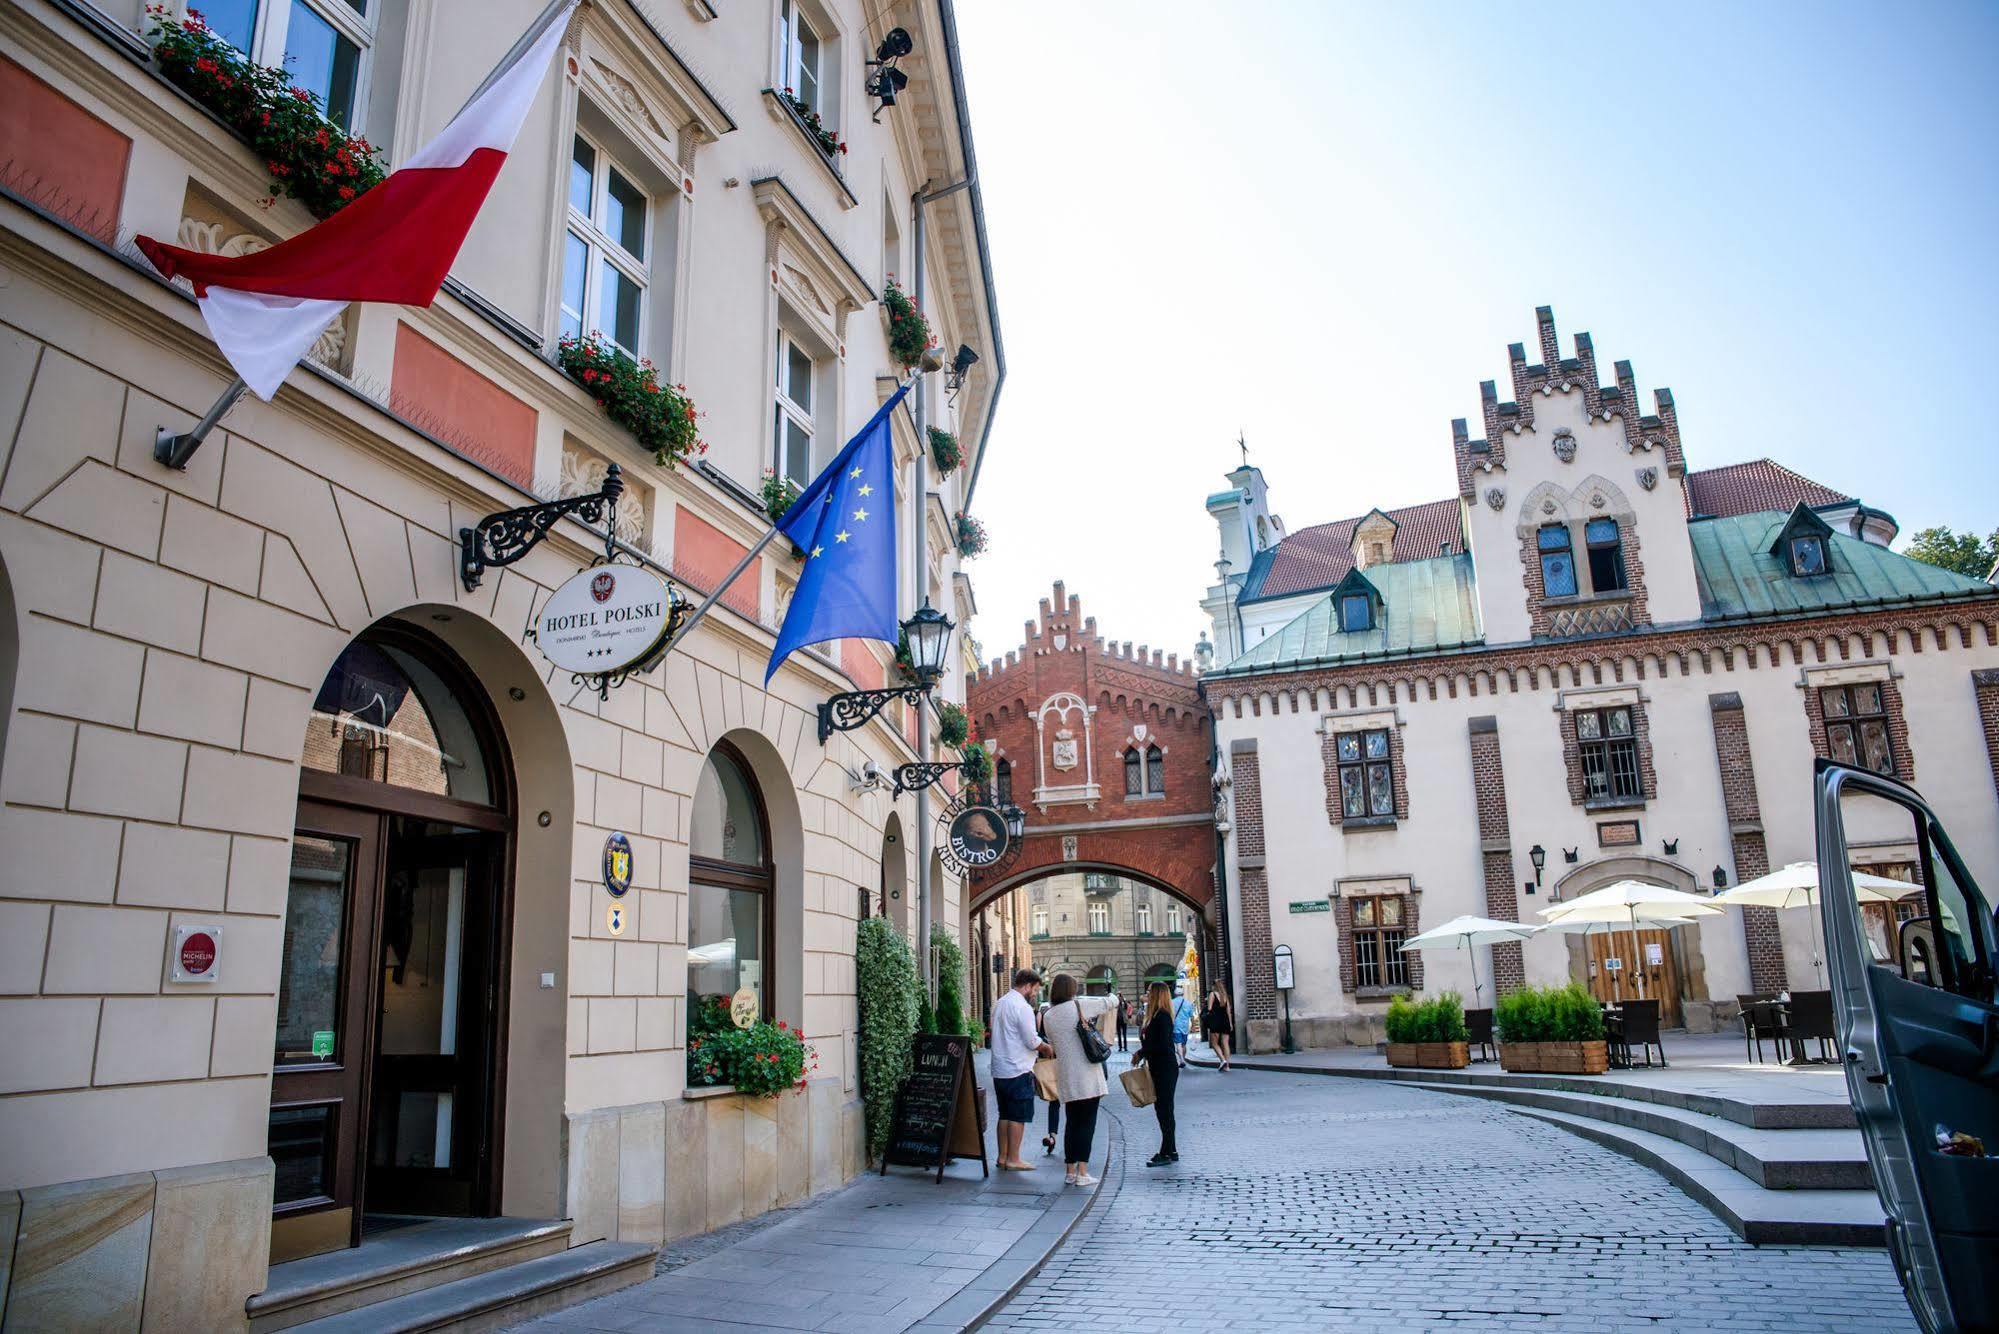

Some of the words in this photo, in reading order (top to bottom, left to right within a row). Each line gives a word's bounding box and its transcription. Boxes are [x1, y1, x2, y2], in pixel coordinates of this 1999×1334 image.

[547, 612, 598, 633] HOTEL
[605, 602, 662, 623] POLSKI
[951, 836, 997, 863] BISTRO
